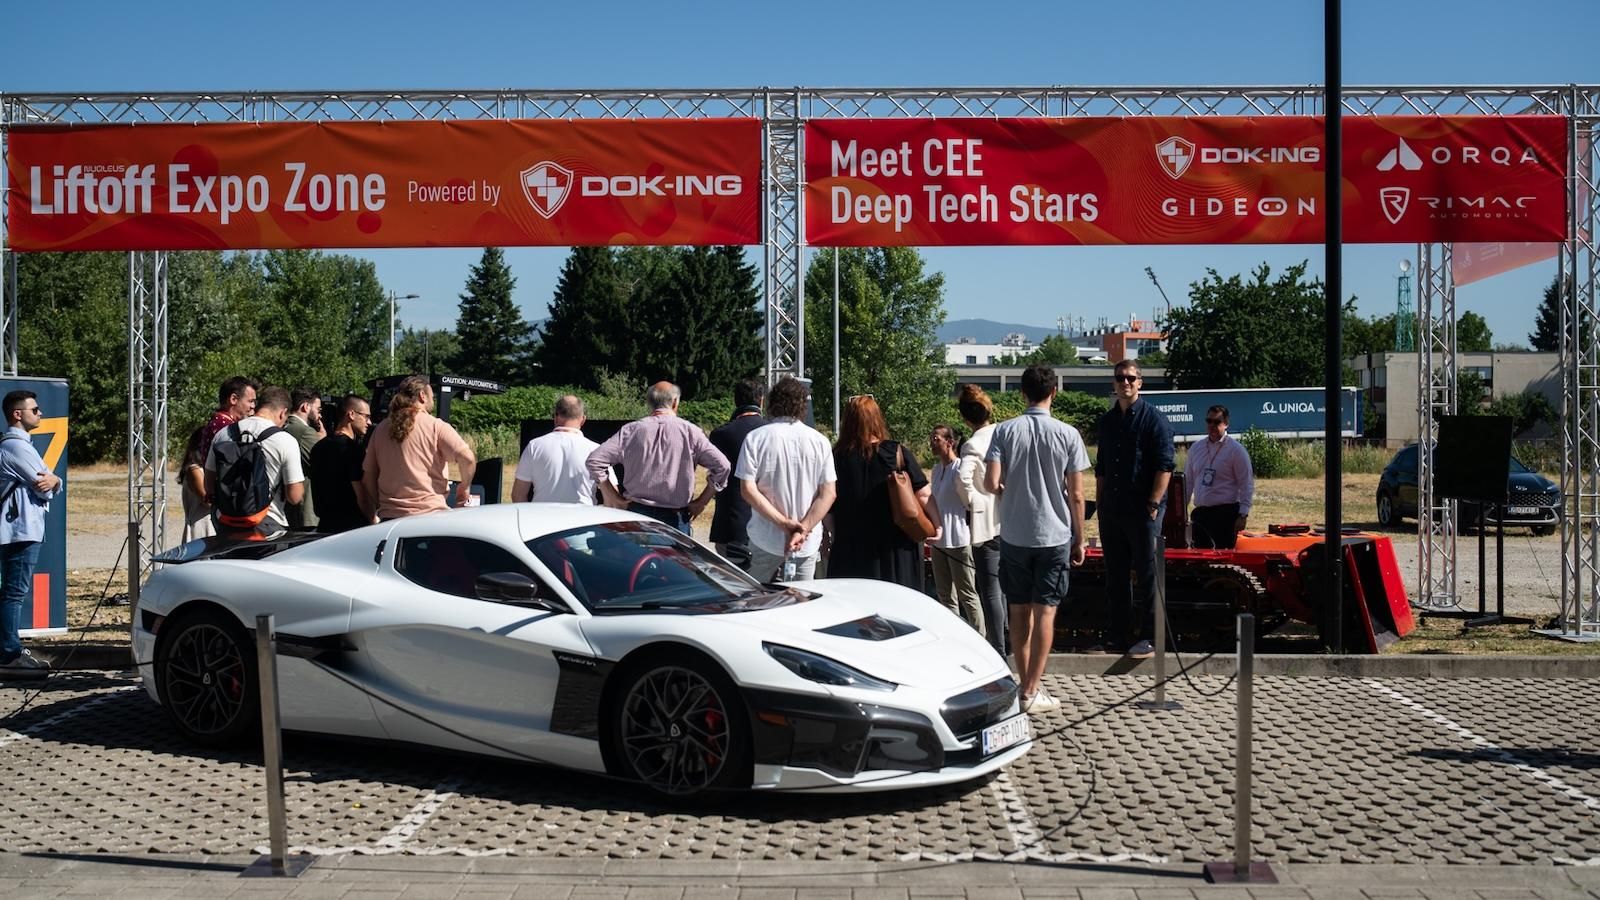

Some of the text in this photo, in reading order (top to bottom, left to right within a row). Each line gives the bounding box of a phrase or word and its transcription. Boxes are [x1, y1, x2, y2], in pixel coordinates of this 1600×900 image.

[831, 138, 984, 178] Meet CEE
[1200, 147, 1320, 164] DOK-ING
[1431, 146, 1539, 166] ORQA
[30, 162, 386, 225] Liftoff Expo Zone
[408, 180, 501, 207] Powered by
[581, 174, 742, 197] DOK-ING
[831, 184, 1099, 233] Deep Tech Stars
[1161, 197, 1315, 217] GIDEON
[1417, 196, 1537, 208] RIMAC
[1279, 402, 1316, 413] UNIQA
